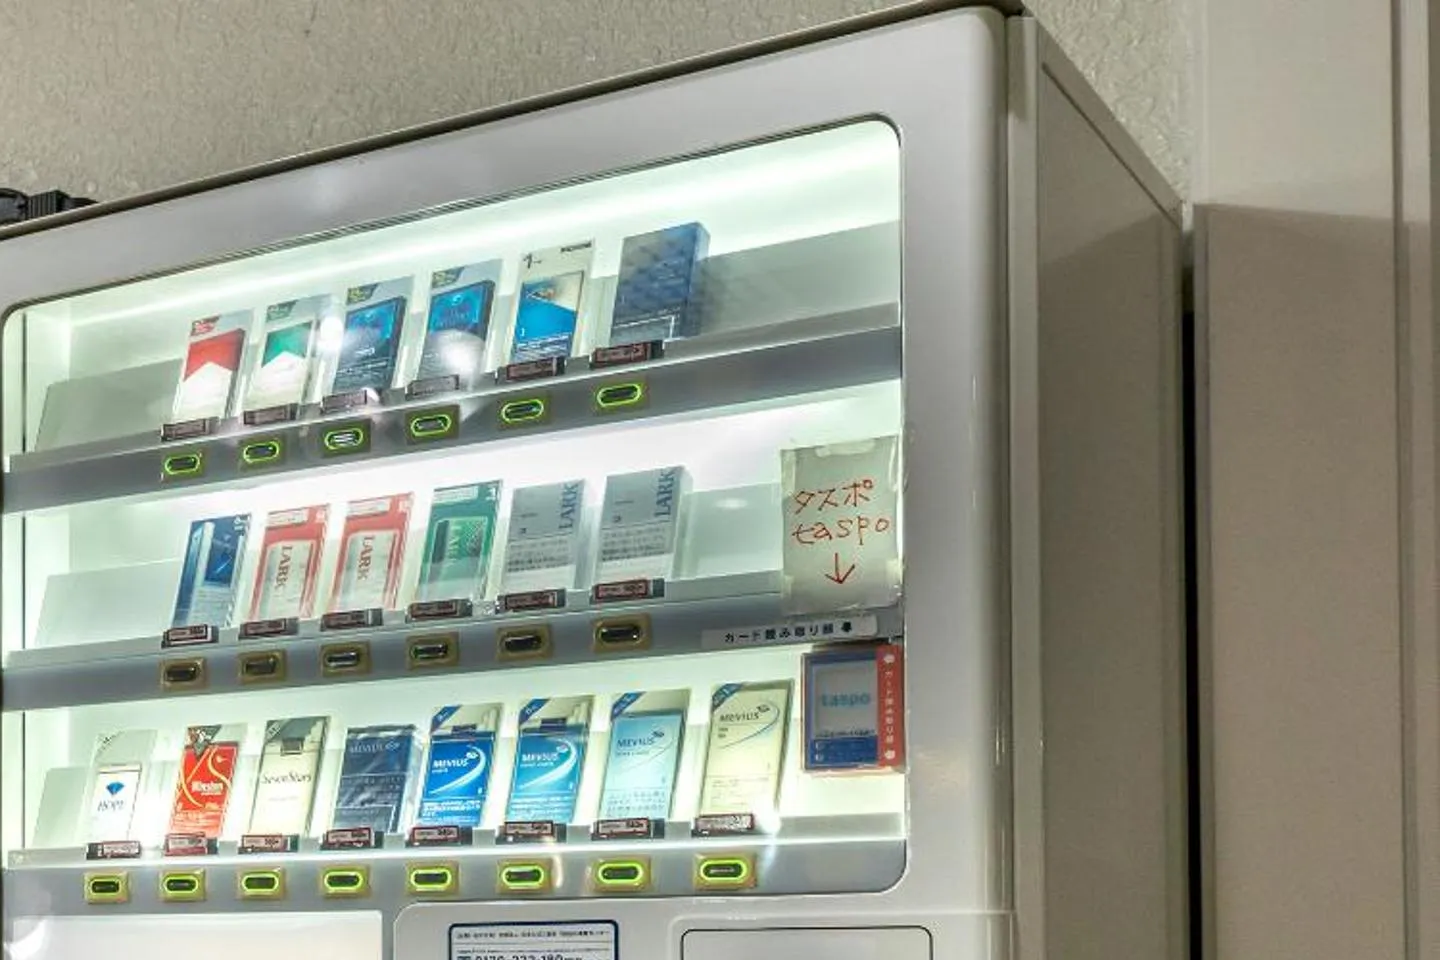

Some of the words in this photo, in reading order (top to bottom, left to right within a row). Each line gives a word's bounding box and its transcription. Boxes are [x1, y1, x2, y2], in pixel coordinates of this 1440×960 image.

[795, 480, 873, 514] タスポ
[793, 515, 889, 545] taspo
[719, 712, 760, 723] MEVIUS
